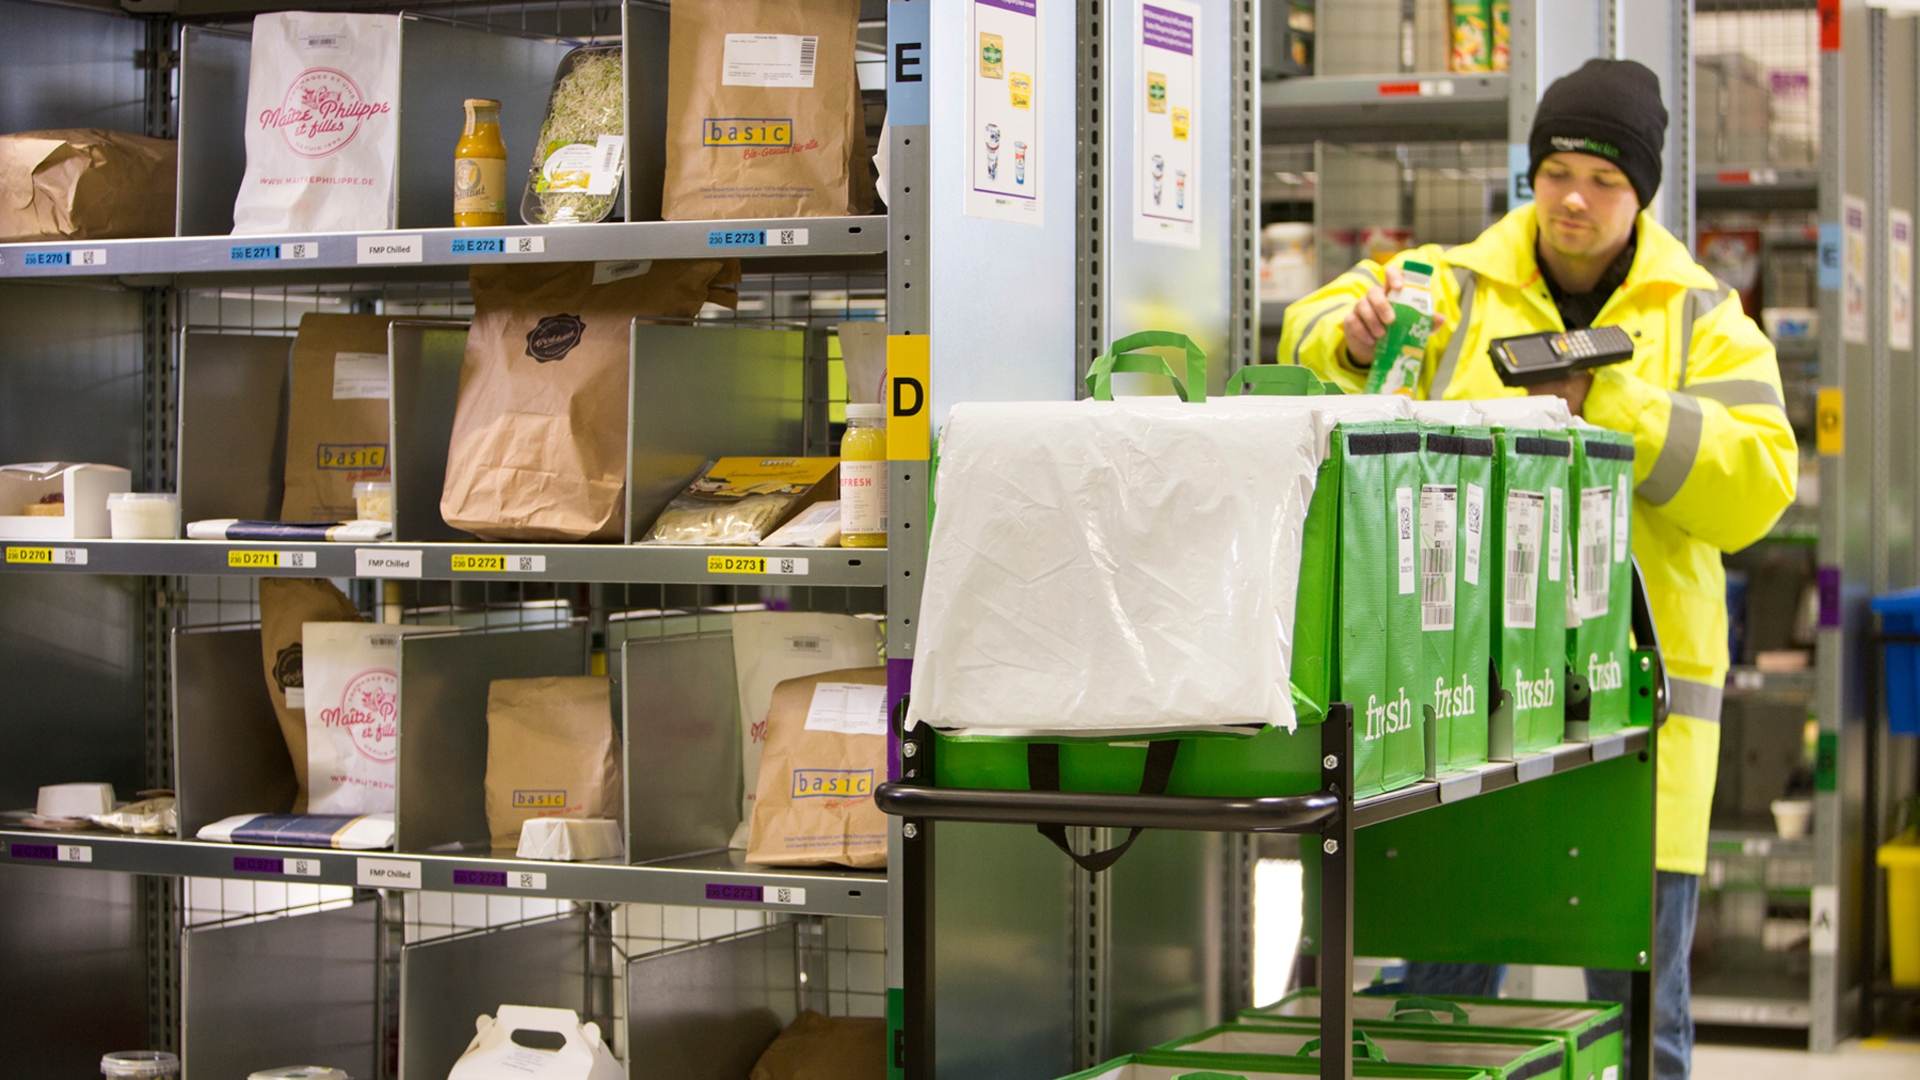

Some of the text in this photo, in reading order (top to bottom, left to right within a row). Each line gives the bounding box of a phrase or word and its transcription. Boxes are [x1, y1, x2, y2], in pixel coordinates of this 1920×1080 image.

[895, 42, 922, 83] E
[320, 100, 390, 120] Philippe
[295, 121, 344, 138] et filles
[710, 120, 784, 141] basic
[805, 139, 818, 150] alle
[726, 234, 732, 243] E
[735, 233, 755, 243] 273
[386, 246, 410, 254] Chilled
[467, 242, 474, 250] E
[476, 241, 495, 250] 272
[246, 249, 251, 257] E
[254, 248, 270, 257] 271
[38, 254, 44, 264] E
[46, 254, 63, 263] 270
[894, 378, 924, 416] D
[324, 445, 378, 466] basic
[20, 550, 27, 559] D
[29, 551, 45, 560] 270
[244, 554, 250, 563] D
[253, 555, 270, 563] 271
[386, 560, 409, 568] Chilled
[468, 558, 476, 567] D
[478, 558, 496, 567] 272
[726, 559, 733, 569] D
[736, 560, 756, 570] 273
[1588, 651, 1622, 692] frsh
[320, 707, 375, 728] Maître
[362, 726, 373, 738] et
[799, 771, 866, 793] basic
[517, 792, 562, 805] basic
[24, 846, 32, 855] C
[34, 847, 48, 856] 270
[387, 870, 411, 878] Chilled
[469, 872, 476, 882] C
[479, 873, 497, 883] 272
[722, 887, 731, 897] C
[734, 888, 753, 898] 273
